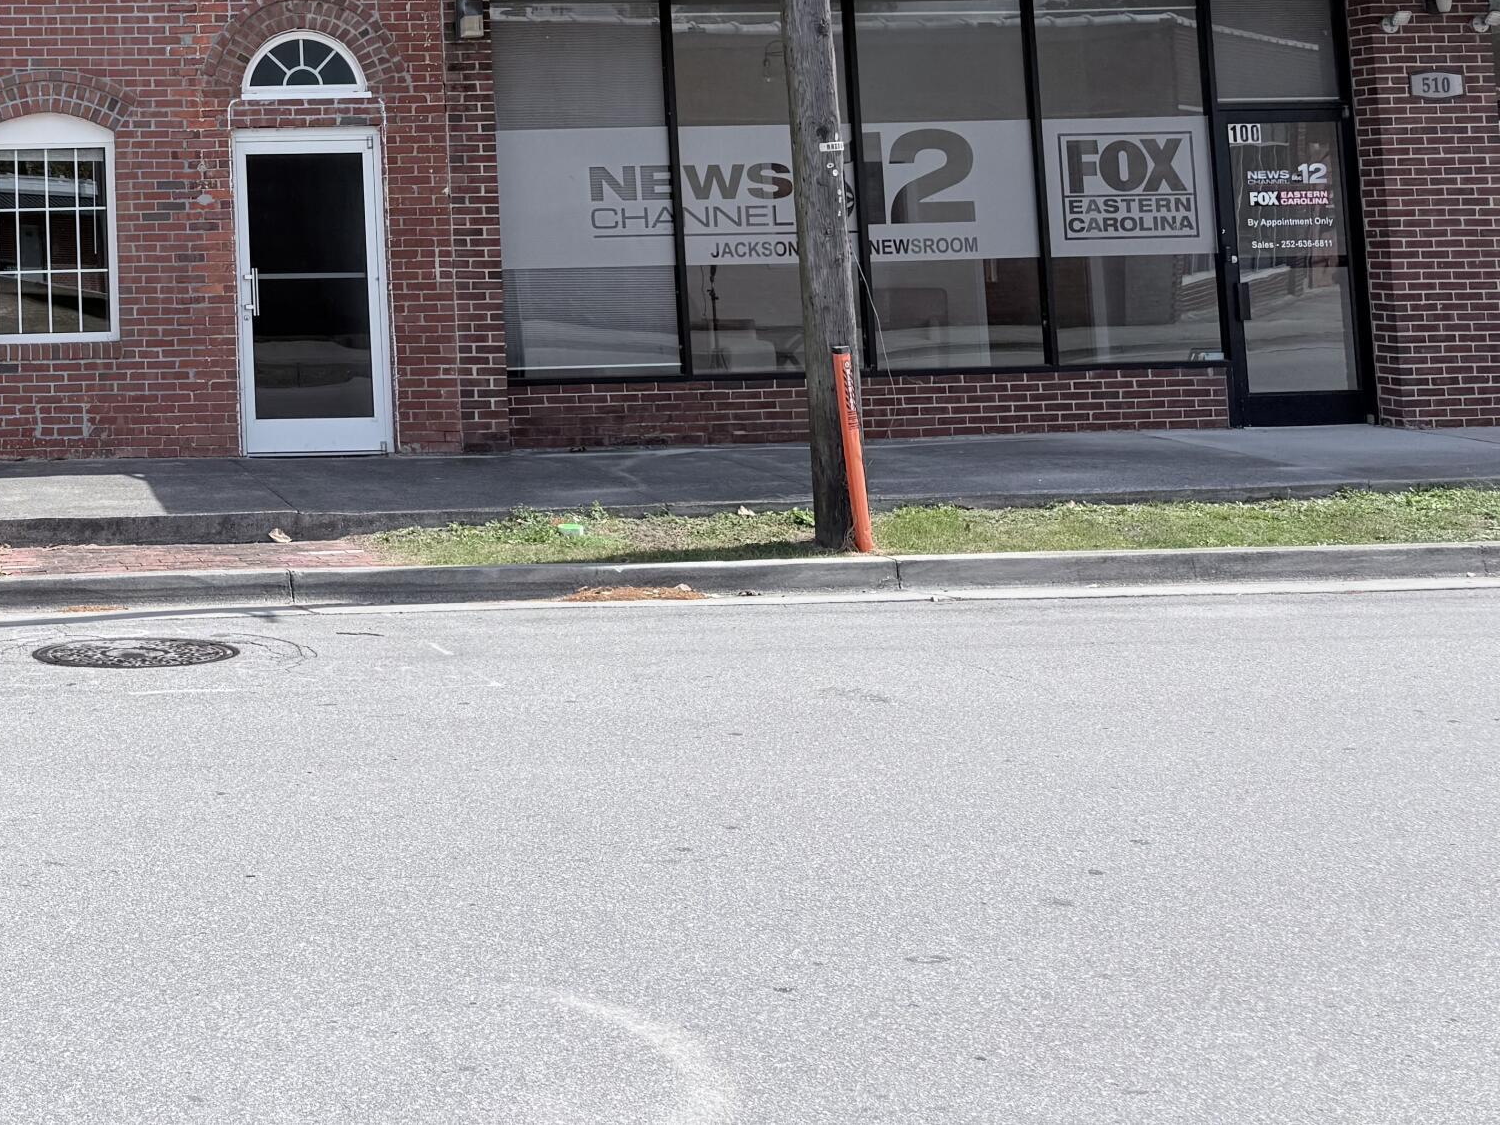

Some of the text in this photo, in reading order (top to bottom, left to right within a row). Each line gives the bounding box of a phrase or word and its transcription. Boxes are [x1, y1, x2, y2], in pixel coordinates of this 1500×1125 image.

[1422, 77, 1450, 93] 510
[1230, 124, 1260, 143] 100
[1066, 138, 1188, 194] FOX
[1247, 170, 1290, 179] NEWS
[1297, 162, 1328, 184] 12
[589, 163, 793, 202] NEWS
[1249, 191, 1279, 206] FOX
[1280, 191, 1328, 199] EASTERN
[1280, 197, 1329, 205] CAROLINA
[1068, 197, 1192, 215] EASTERN
[591, 205, 794, 229] CHANNEL
[1068, 216, 1195, 233] CAROLINA
[1247, 216, 1334, 227] By Appointment Only
[711, 237, 978, 258] JACKSON NEWSROOM
[1251, 241, 1274, 249] Sales
